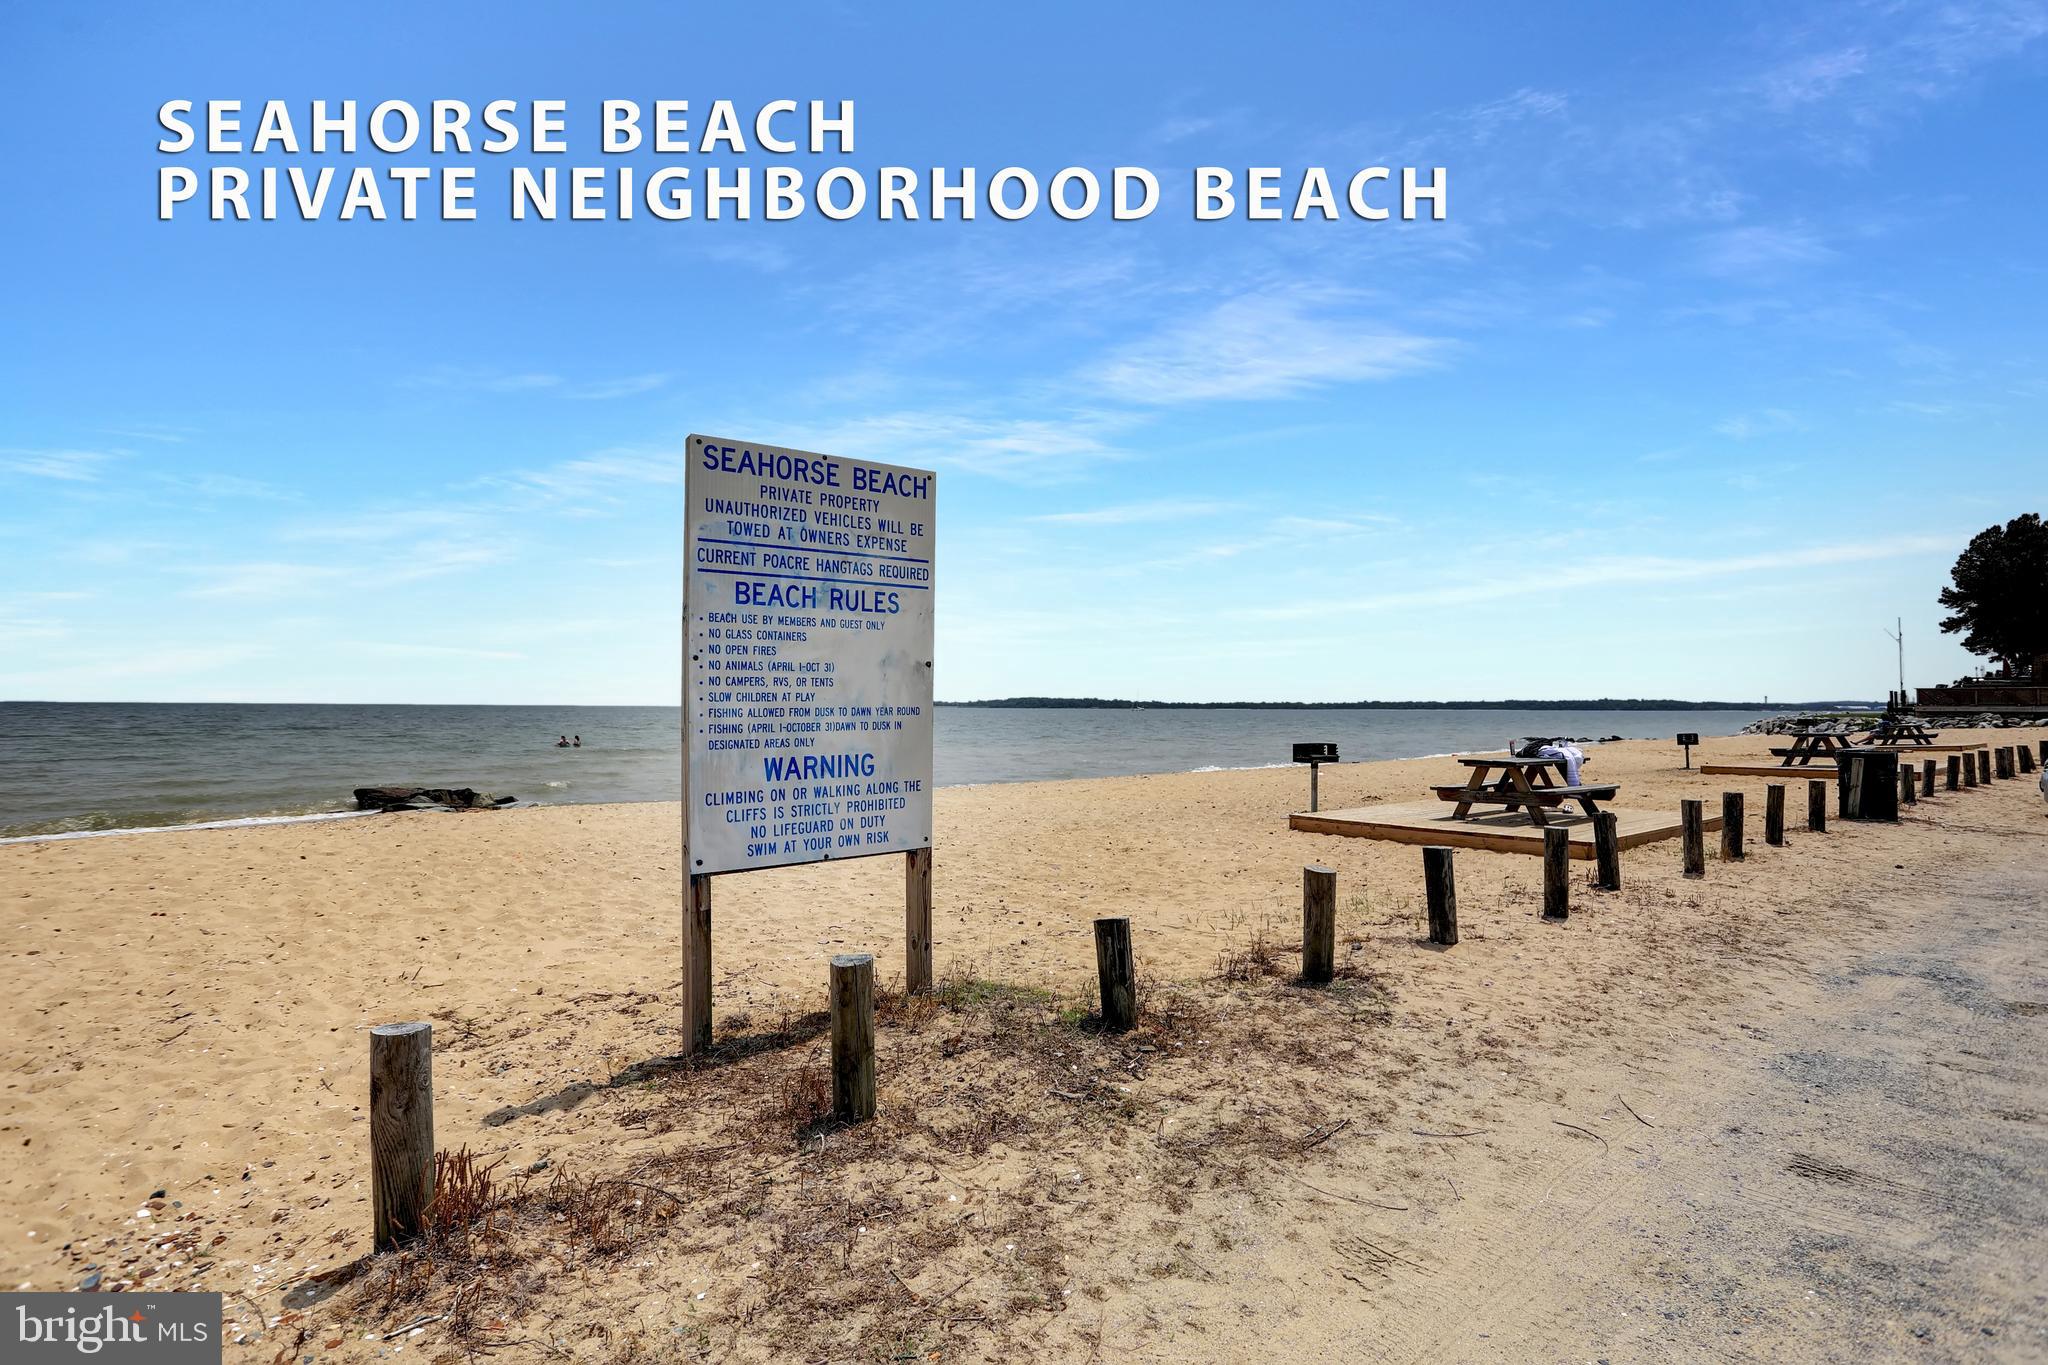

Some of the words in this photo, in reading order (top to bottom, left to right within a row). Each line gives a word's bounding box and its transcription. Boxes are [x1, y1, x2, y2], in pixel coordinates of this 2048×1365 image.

[703, 445, 840, 487] SEAHORSE
[853, 467, 927, 499] BEACH
[760, 485, 812, 505] PRIVATE
[821, 493, 880, 513] PROPERTY
[705, 498, 807, 522] UNAUTHORIZED
[815, 511, 871, 530] VEHICLES
[878, 519, 904, 534] WILL
[911, 523, 923, 536] BE
[727, 520, 770, 538] TOWED
[778, 526, 792, 540] AT
[801, 529, 849, 546] OWNERS
[857, 535, 908, 552] EXPENSE
[698, 548, 756, 566] CURRENT
[764, 554, 810, 570] POACRE
[816, 559, 873, 576] HANGTAGS
[880, 565, 928, 581] REQUIRED
[735, 582, 816, 607] BEACH
[831, 588, 899, 614] RULES
[709, 613, 737, 624] BEACH
[742, 614, 759, 624] USE
[763, 615, 773, 625] BY
[778, 616, 816, 627] MEMBERS
[821, 618, 835, 628] AND
[840, 619, 862, 629] GUEST
[866, 620, 885, 630] ONLY
[709, 629, 720, 639] NO
[726, 630, 752, 639] GLASS
[757, 631, 807, 641] CONTAINERS
[709, 645, 720, 655] NO
[726, 646, 748, 655] OPEN
[753, 646, 776, 655] FIRES
[709, 661, 720, 670] NO
[725, 661, 763, 671] ANIMALS
[768, 662, 795, 672] (APRIL
[825, 662, 834, 672] 31)
[709, 677, 720, 687] NO
[726, 677, 768, 687] CAMPERS,
[773, 677, 791, 688] RVS,
[796, 677, 806, 687] OR
[811, 678, 833, 687] TENTS
[709, 693, 731, 702] SLOW
[736, 693, 777, 702] CHILDREN
[782, 693, 791, 702] AT
[796, 693, 815, 702] PLAY
[709, 708, 743, 718] FISHING
[748, 708, 784, 718] ALLOWED
[789, 707, 810, 717] FROM
[815, 707, 834, 716] DUSK
[839, 707, 847, 716] TO
[851, 707, 871, 716] DAWN
[876, 707, 893, 716] YEAR
[897, 706, 920, 716] ROUND
[709, 724, 743, 734] FISHING
[748, 723, 775, 733] (APRIL
[860, 721, 868, 730] TO
[873, 721, 891, 730] DUSK
[894, 721, 902, 730] IN
[709, 739, 759, 750] DESIGNATED
[764, 739, 790, 748] AREAS
[794, 738, 815, 747] ONLY
[764, 753, 875, 782] WARNING
[705, 791, 763, 806] CLIMBING
[771, 789, 785, 801] ON
[793, 788, 807, 800] OR
[814, 784, 860, 798] WALKING
[866, 782, 898, 795] ALONG
[904, 780, 921, 792] THE
[726, 808, 766, 823] CLIFFS
[774, 806, 784, 819] IS
[791, 803, 839, 817] STRICTLY
[847, 798, 905, 812] PROHIBITED
[751, 826, 766, 839] NO
[774, 820, 833, 837] LIFEGUARD
[840, 818, 853, 830] ON
[861, 815, 885, 828] DUTY
[747, 844, 776, 857] SWIM
[784, 842, 799, 853] AT
[803, 837, 832, 851] YOUR
[838, 834, 860, 847] OWN
[867, 831, 889, 844] RISK
